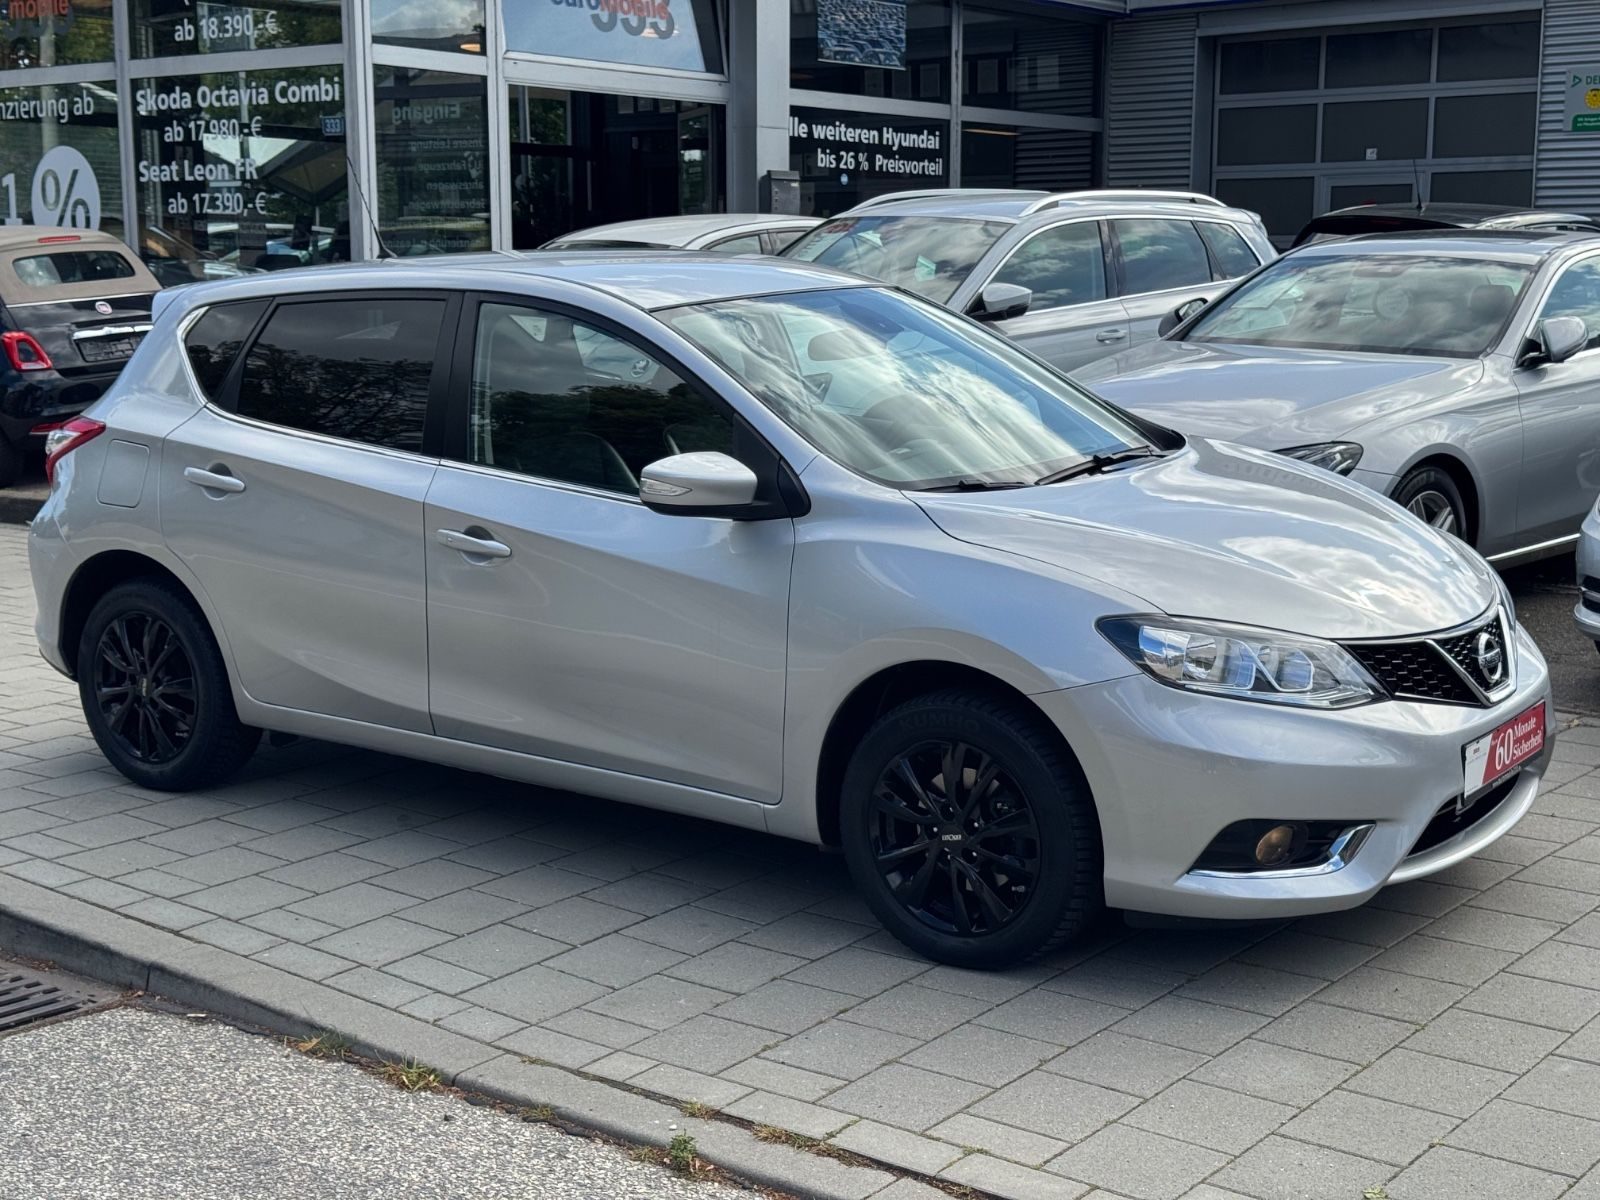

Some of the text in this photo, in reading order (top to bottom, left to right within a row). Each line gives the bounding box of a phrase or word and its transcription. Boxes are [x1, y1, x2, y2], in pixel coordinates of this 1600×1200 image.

[174, 11, 279, 42] ab 18.390,-€
[0, 90, 94, 123] nzierung ab
[136, 86, 192, 112] Skoda
[197, 82, 269, 108] Octavia
[274, 77, 341, 105] Combi
[164, 116, 263, 143] ab 17.980,-€
[812, 121, 879, 145] weiteren
[882, 127, 940, 151] Hyundai
[138, 158, 258, 183] Seat Leon FR
[817, 148, 943, 176] bis 26 % Preisvorteil
[168, 191, 267, 216] ab 17.390,-€
[1495, 728, 1513, 771] 60
[1513, 716, 1536, 740] Monate
